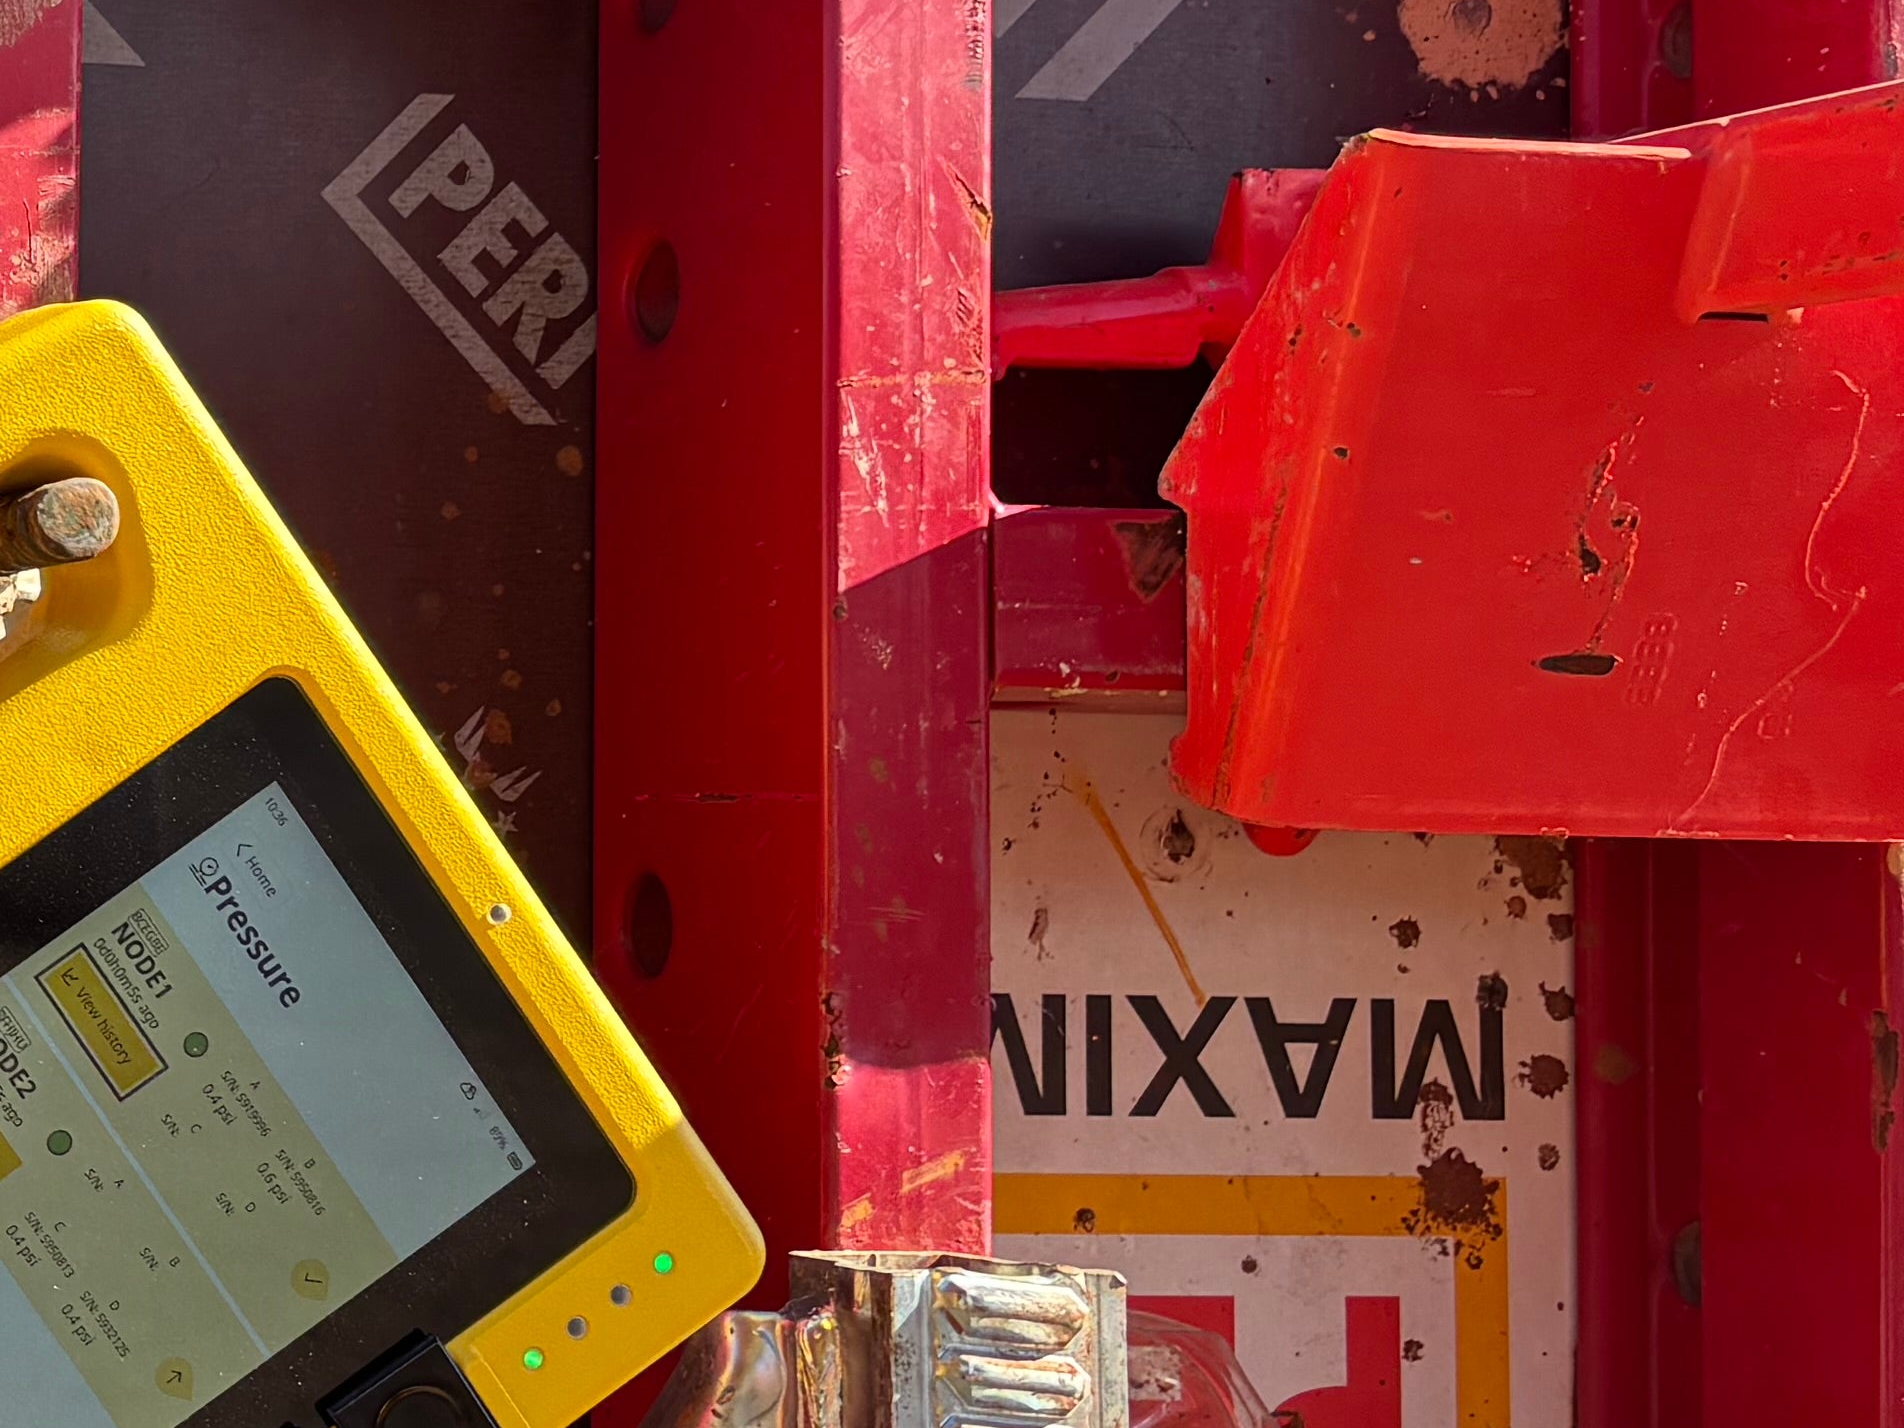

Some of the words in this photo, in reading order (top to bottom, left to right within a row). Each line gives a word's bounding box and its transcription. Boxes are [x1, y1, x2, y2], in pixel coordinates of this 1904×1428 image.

[264, 796, 289, 827] 10:36
[244, 854, 277, 898] Home
[204, 875, 300, 1008] Pressure
[110, 920, 172, 998] NODE1
[75, 985, 102, 1019] View
[96, 1017, 132, 1065] history
[137, 1003, 160, 1029] ago
[201, 1082, 223, 1105] 0.4
[247, 1079, 262, 1091] A
[0, 1101, 24, 1128] ago
[211, 1103, 238, 1126] psi
[219, 1069, 240, 1093] S/N:
[234, 1091, 272, 1137] 5919996
[159, 1112, 180, 1138] S/N:
[188, 1121, 204, 1135] C
[256, 1161, 277, 1184] 0.6
[301, 1156, 317, 1171] B
[82, 1167, 104, 1193] S/N:
[111, 1177, 126, 1190] A
[273, 1148, 295, 1173] S/N:
[289, 1170, 326, 1216] 5950816
[214, 1191, 235, 1217] S/N:
[242, 1199, 258, 1214] D
[266, 1182, 292, 1205] psi
[52, 1219, 67, 1234] C
[4, 1223, 26, 1246] 0.4
[15, 1245, 42, 1267] psi
[23, 1210, 44, 1237] S/N:
[38, 1233, 75, 1279] 5950813
[138, 1246, 159, 1272] S/N:
[166, 1254, 182, 1269] B
[60, 1302, 81, 1325] 0.4
[106, 1297, 121, 1312] D
[70, 1324, 96, 1346] psi
[78, 1289, 99, 1315] S/N:
[94, 1311, 131, 1358] 5932125
